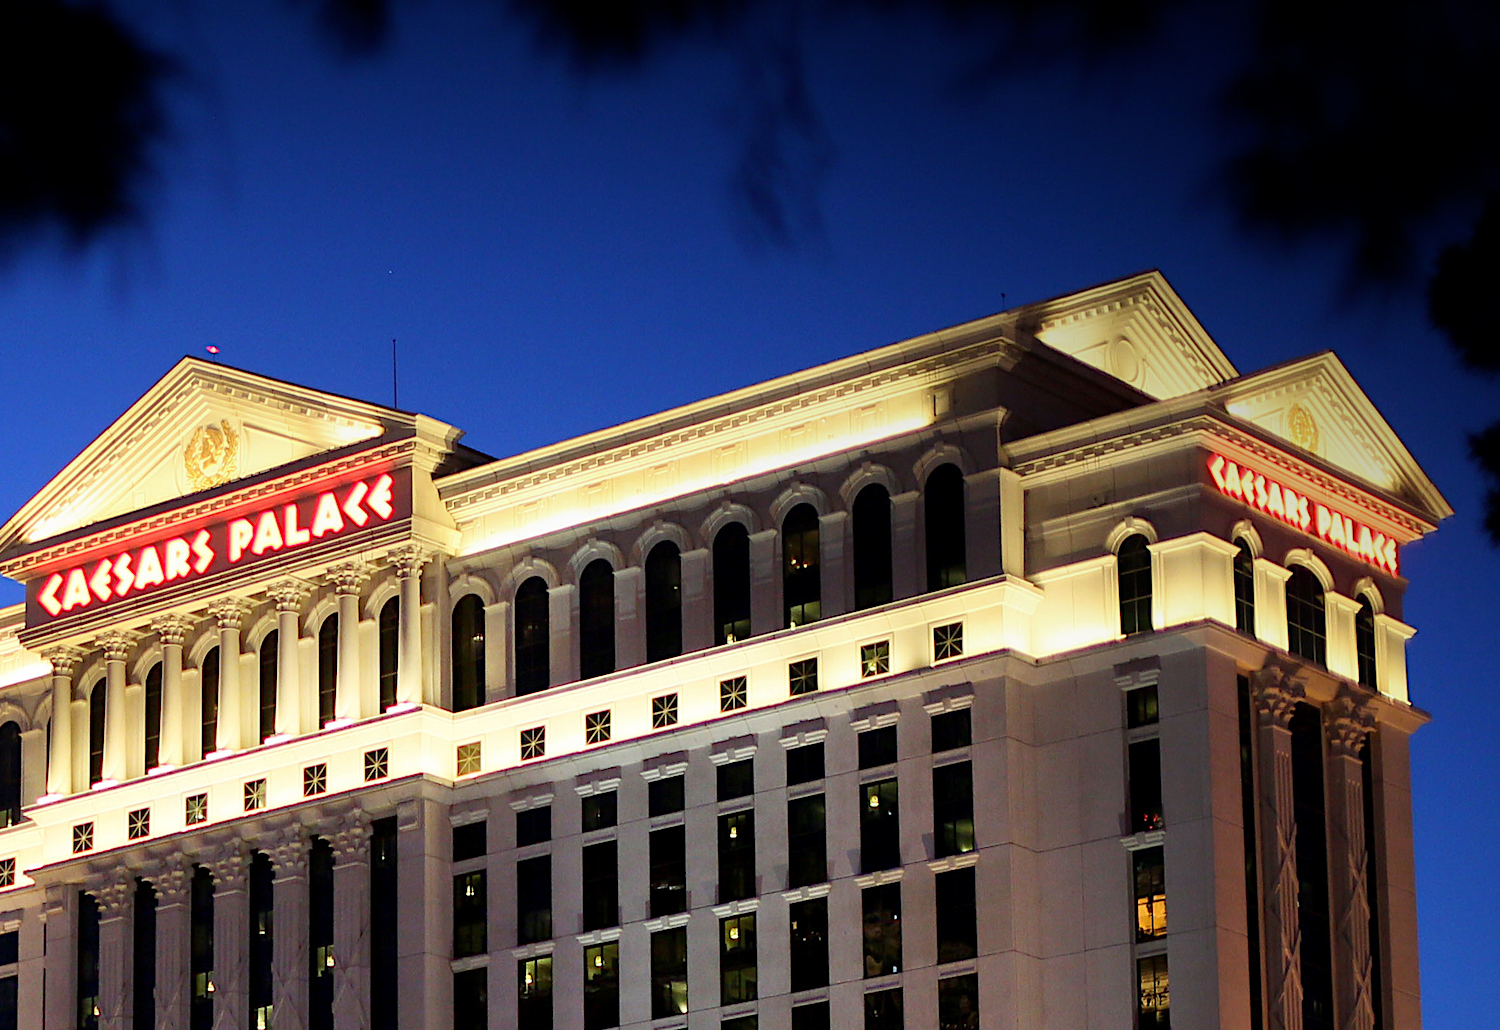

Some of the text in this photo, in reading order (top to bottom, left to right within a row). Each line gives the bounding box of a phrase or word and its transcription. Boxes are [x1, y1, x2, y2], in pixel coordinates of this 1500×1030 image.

[36, 472, 396, 618] CAESARS PALACE
[1206, 451, 1398, 580] CAESARS PALACE
